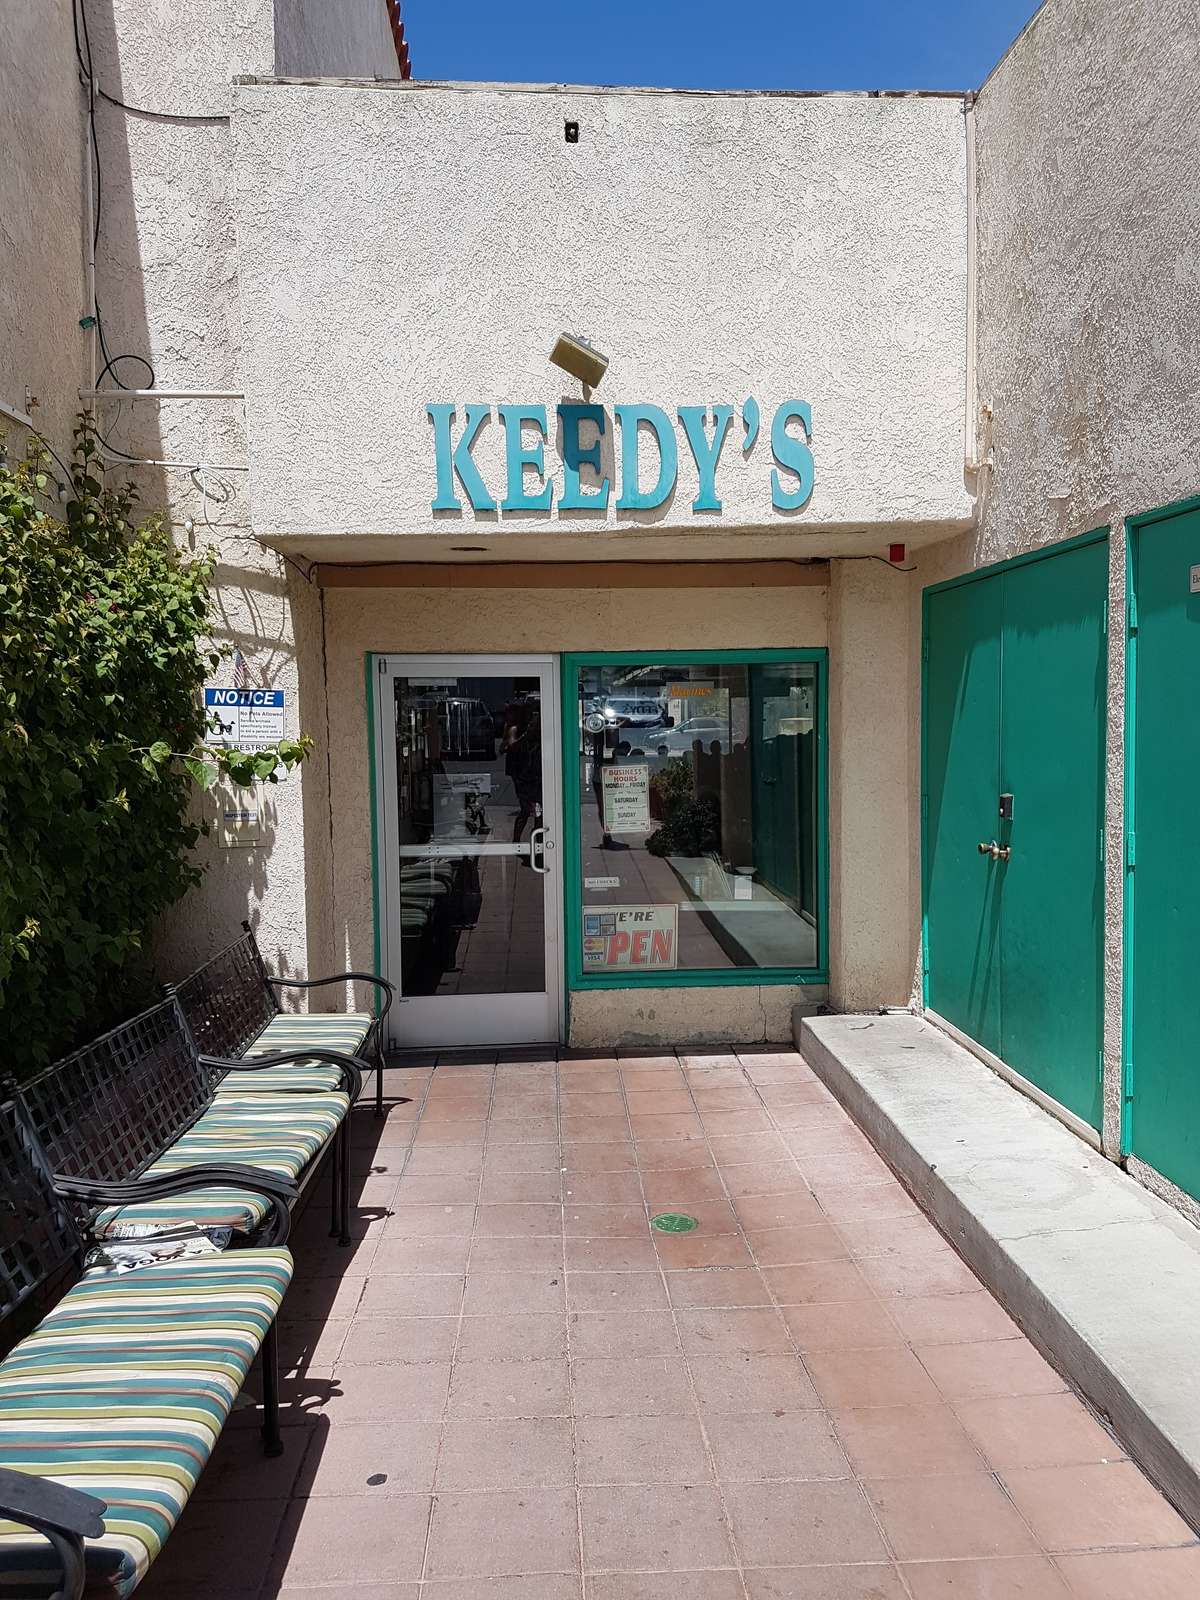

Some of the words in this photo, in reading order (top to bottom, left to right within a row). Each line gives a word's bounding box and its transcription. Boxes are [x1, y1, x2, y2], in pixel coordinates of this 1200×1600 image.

[425, 395, 815, 513] KEEDY'S
[214, 690, 275, 705] NOTICE
[615, 911, 655, 922] E'RE
[605, 929, 673, 965] PEN
